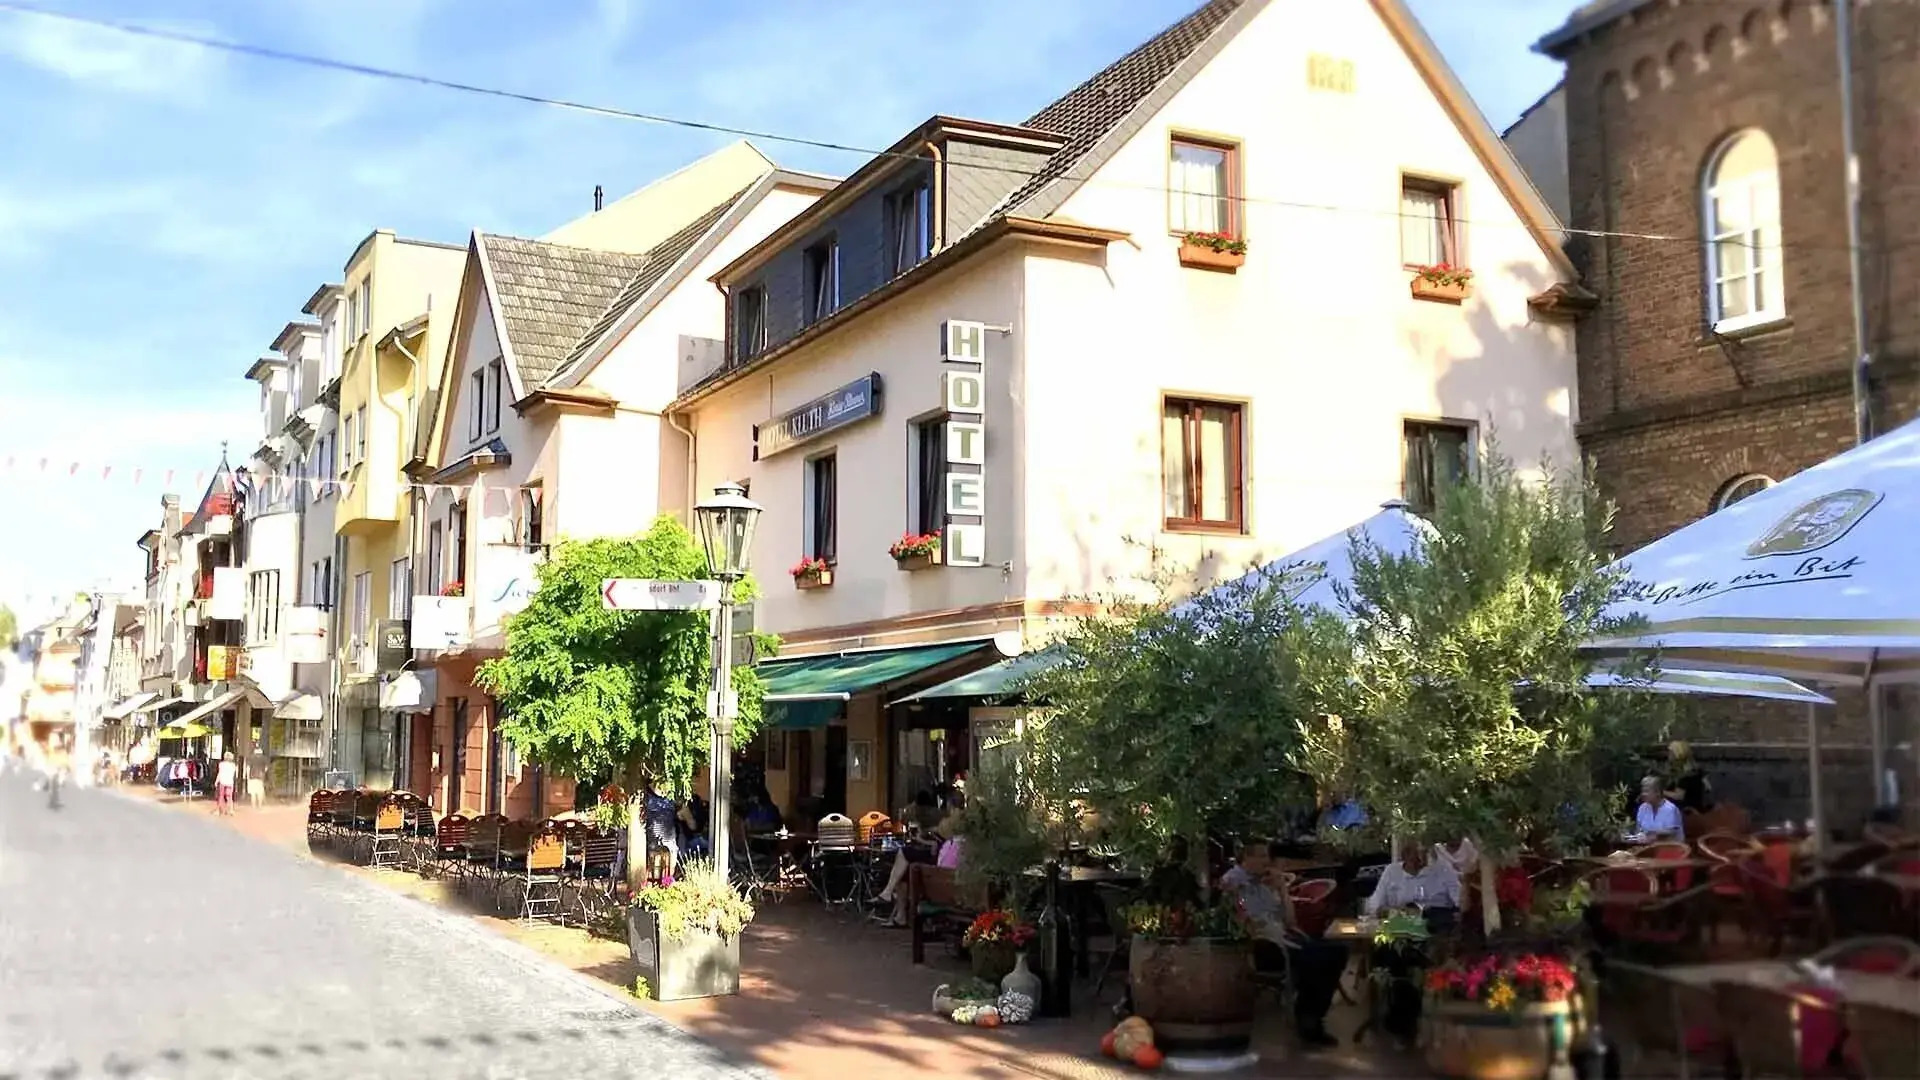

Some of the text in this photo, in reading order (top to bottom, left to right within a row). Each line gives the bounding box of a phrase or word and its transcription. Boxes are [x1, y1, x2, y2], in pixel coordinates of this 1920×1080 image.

[952, 325, 979, 563] HOTEL
[1652, 555, 1866, 604] Bitte ein Bit
